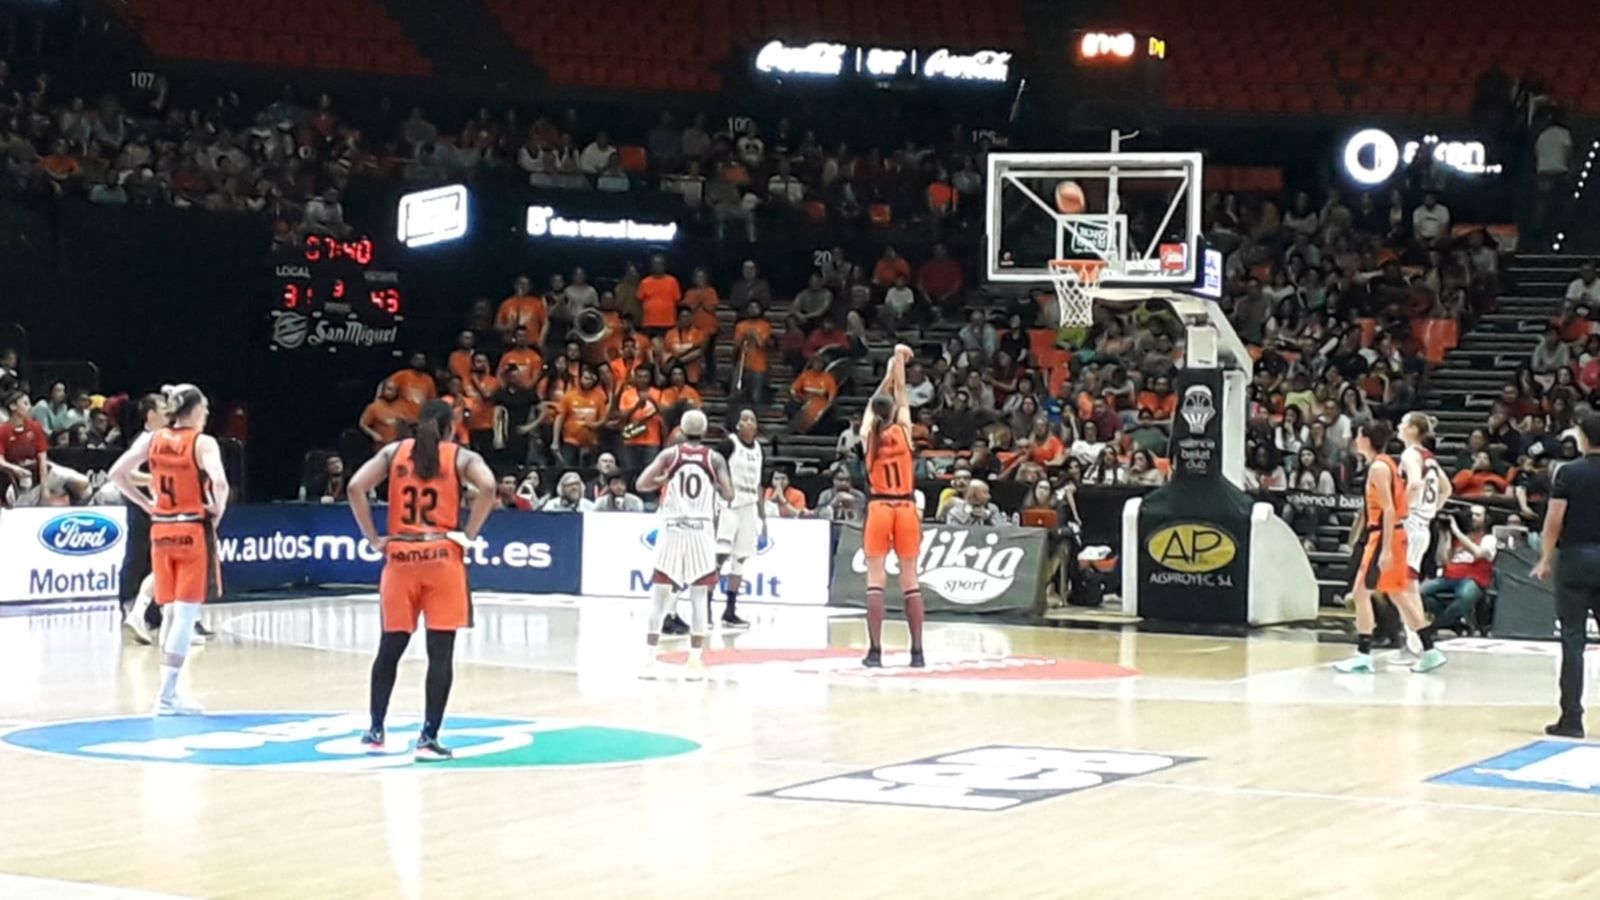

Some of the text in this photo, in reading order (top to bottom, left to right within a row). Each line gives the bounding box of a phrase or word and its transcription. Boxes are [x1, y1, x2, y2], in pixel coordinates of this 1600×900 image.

[130, 71, 155, 89] 107
[306, 236, 371, 264] 07:40
[276, 266, 311, 278] LOCAL
[370, 289, 399, 313] 43
[679, 470, 702, 499] 10
[883, 462, 901, 488] 11
[160, 476, 177, 507] 4
[401, 485, 438, 526] 32
[1286, 492, 1335, 507] valencia
[54, 516, 107, 548] Ford
[1161, 530, 1222, 565] AP
[29, 563, 117, 594] Montal
[944, 576, 988, 593] sport
